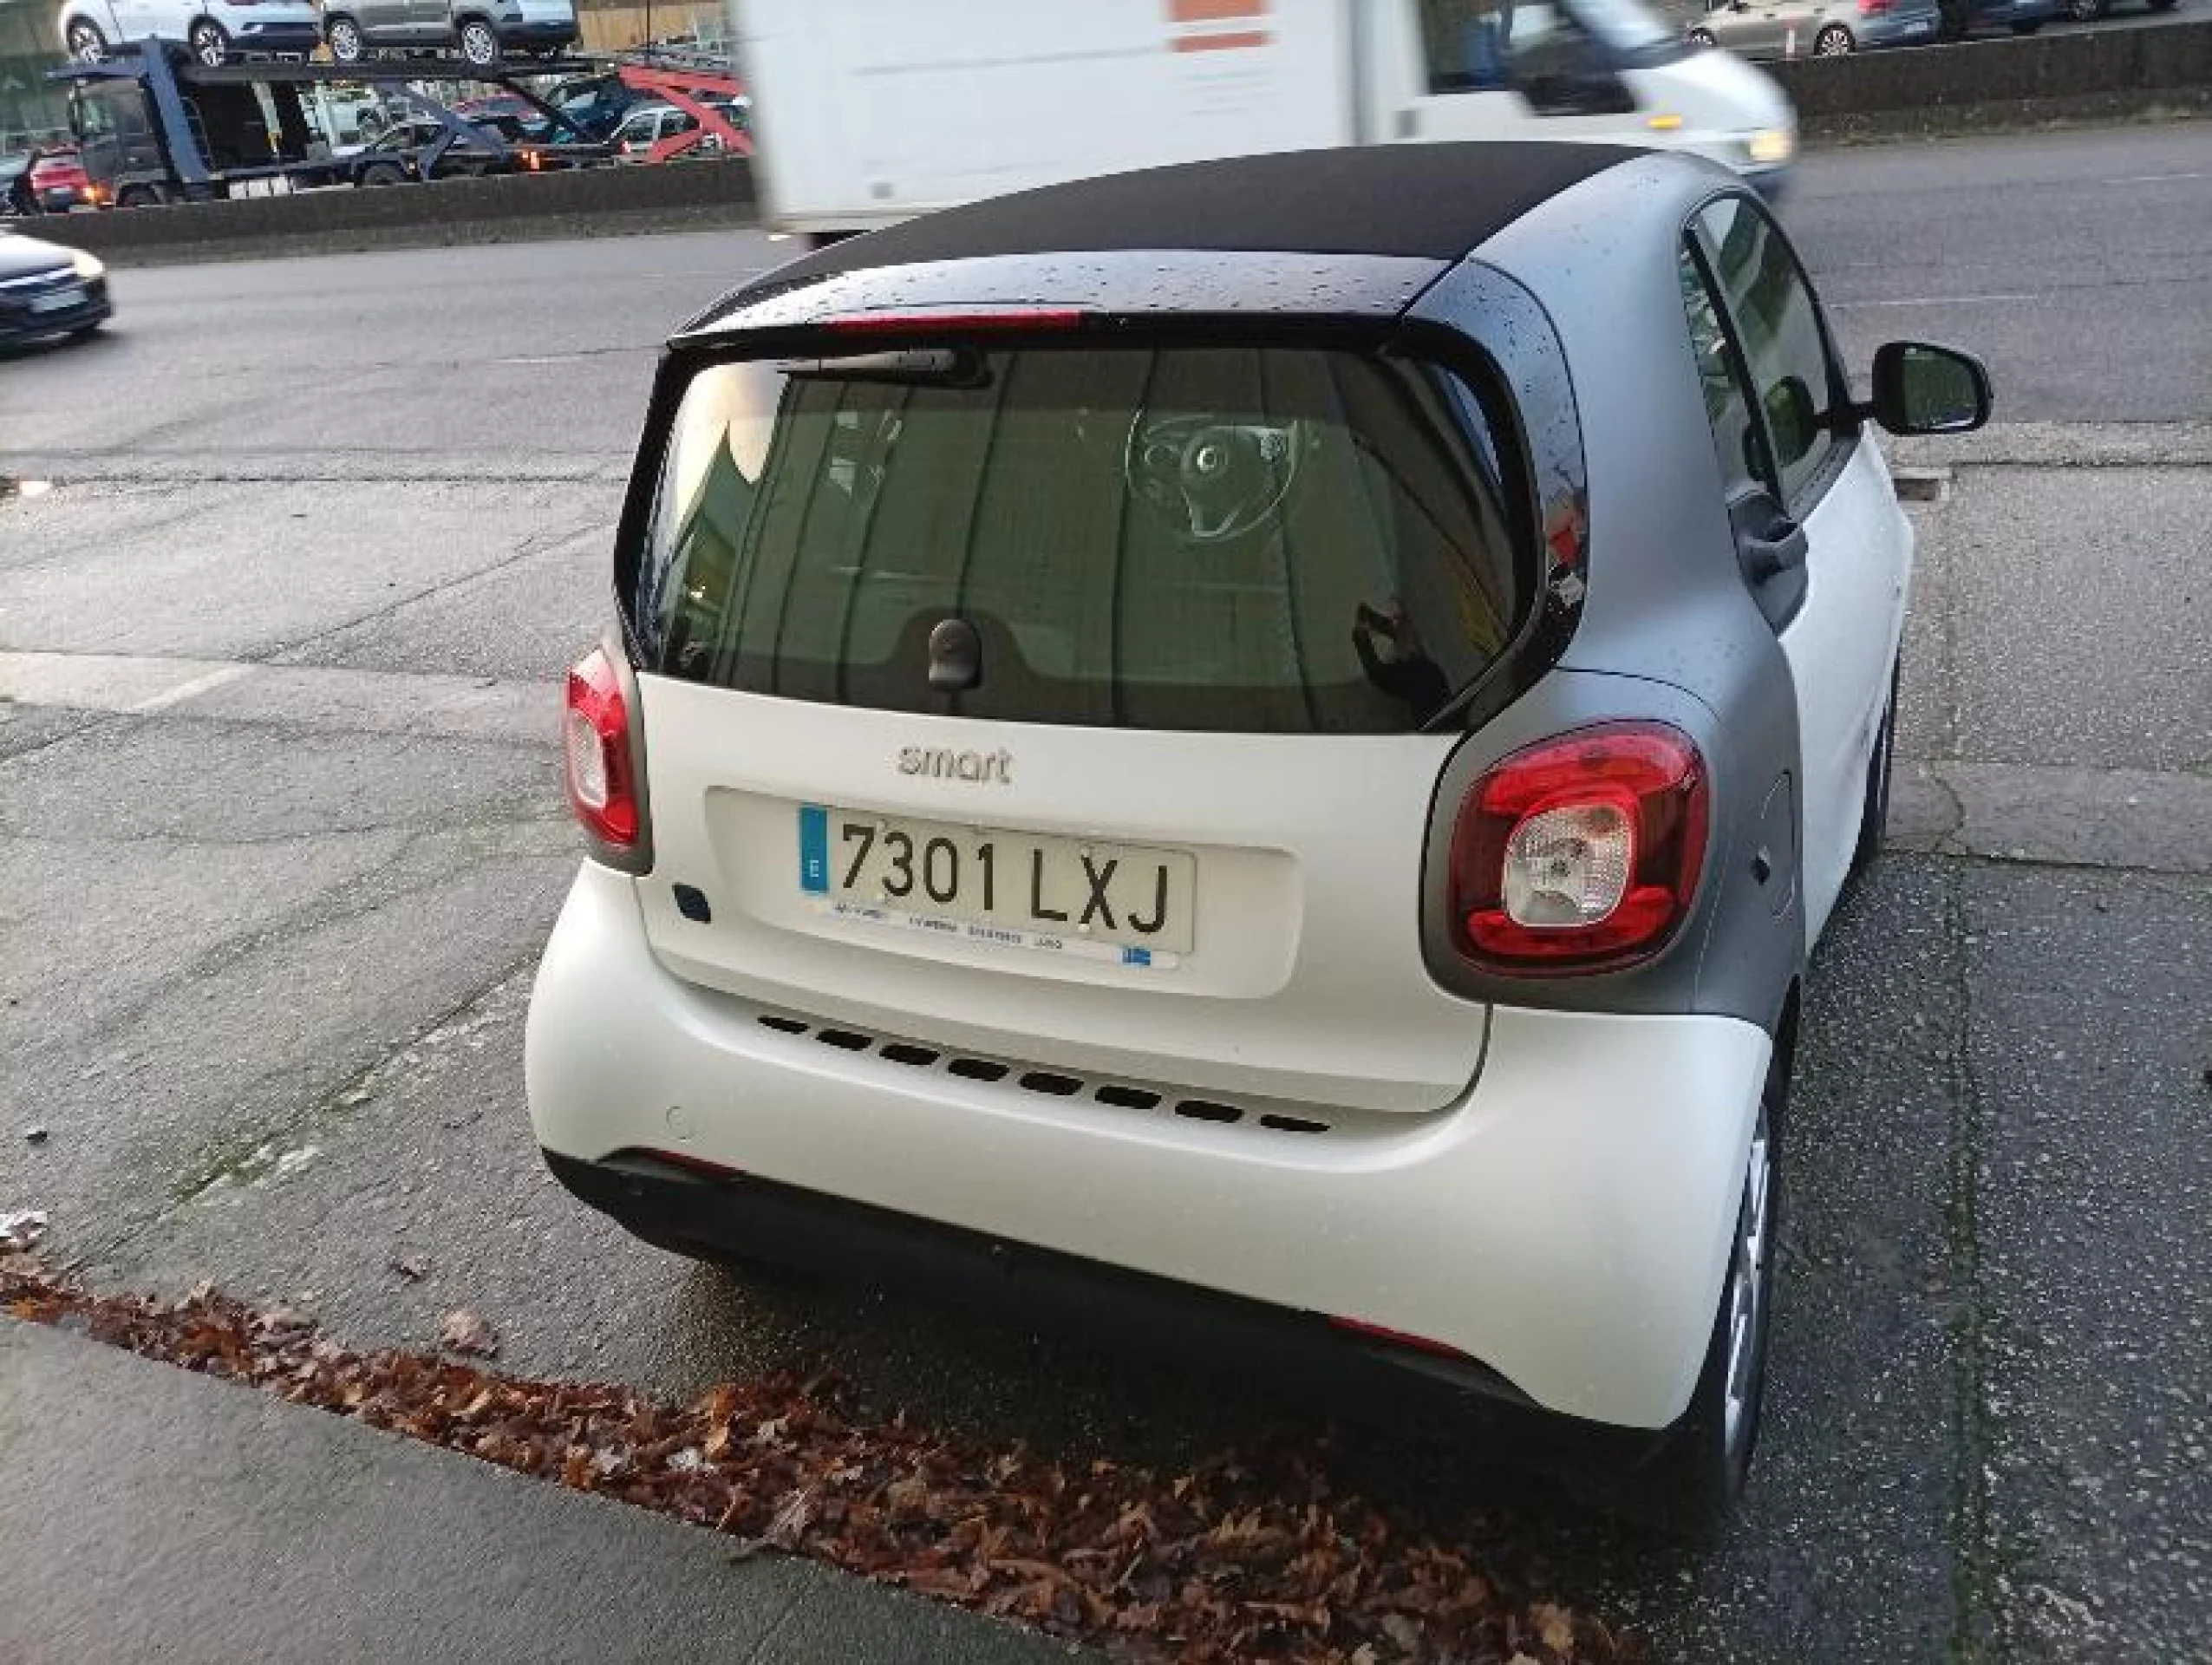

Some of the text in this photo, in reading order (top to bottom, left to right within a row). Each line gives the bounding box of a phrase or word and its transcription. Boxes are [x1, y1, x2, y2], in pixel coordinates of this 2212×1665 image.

[898, 747, 1013, 786] smart
[809, 859, 819, 878] E
[843, 824, 1167, 933] 7301 LXJ
